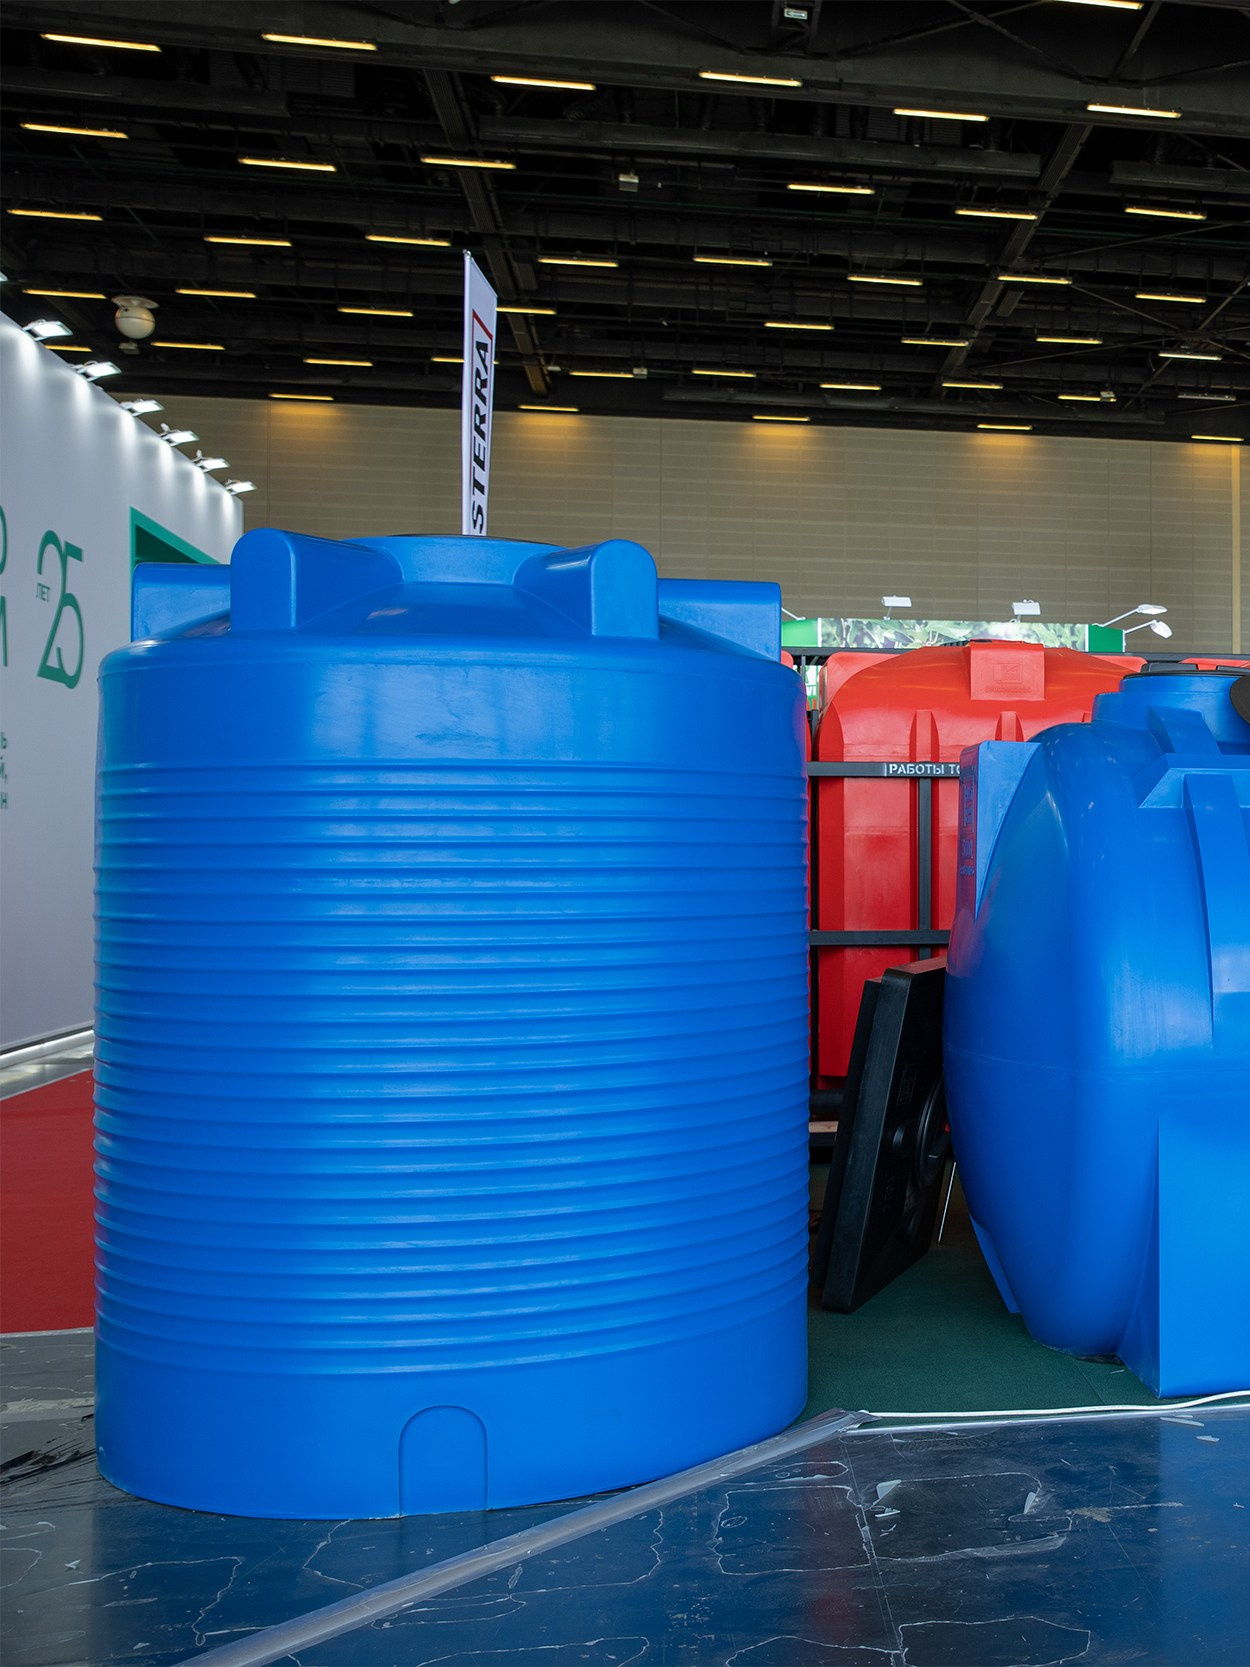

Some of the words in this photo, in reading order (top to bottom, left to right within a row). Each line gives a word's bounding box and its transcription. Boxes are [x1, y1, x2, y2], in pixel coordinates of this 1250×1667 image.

[36, 582, 51, 603] ЛЕТ
[37, 529, 84, 690] 25
[889, 763, 945, 775] РАБОТЫ
